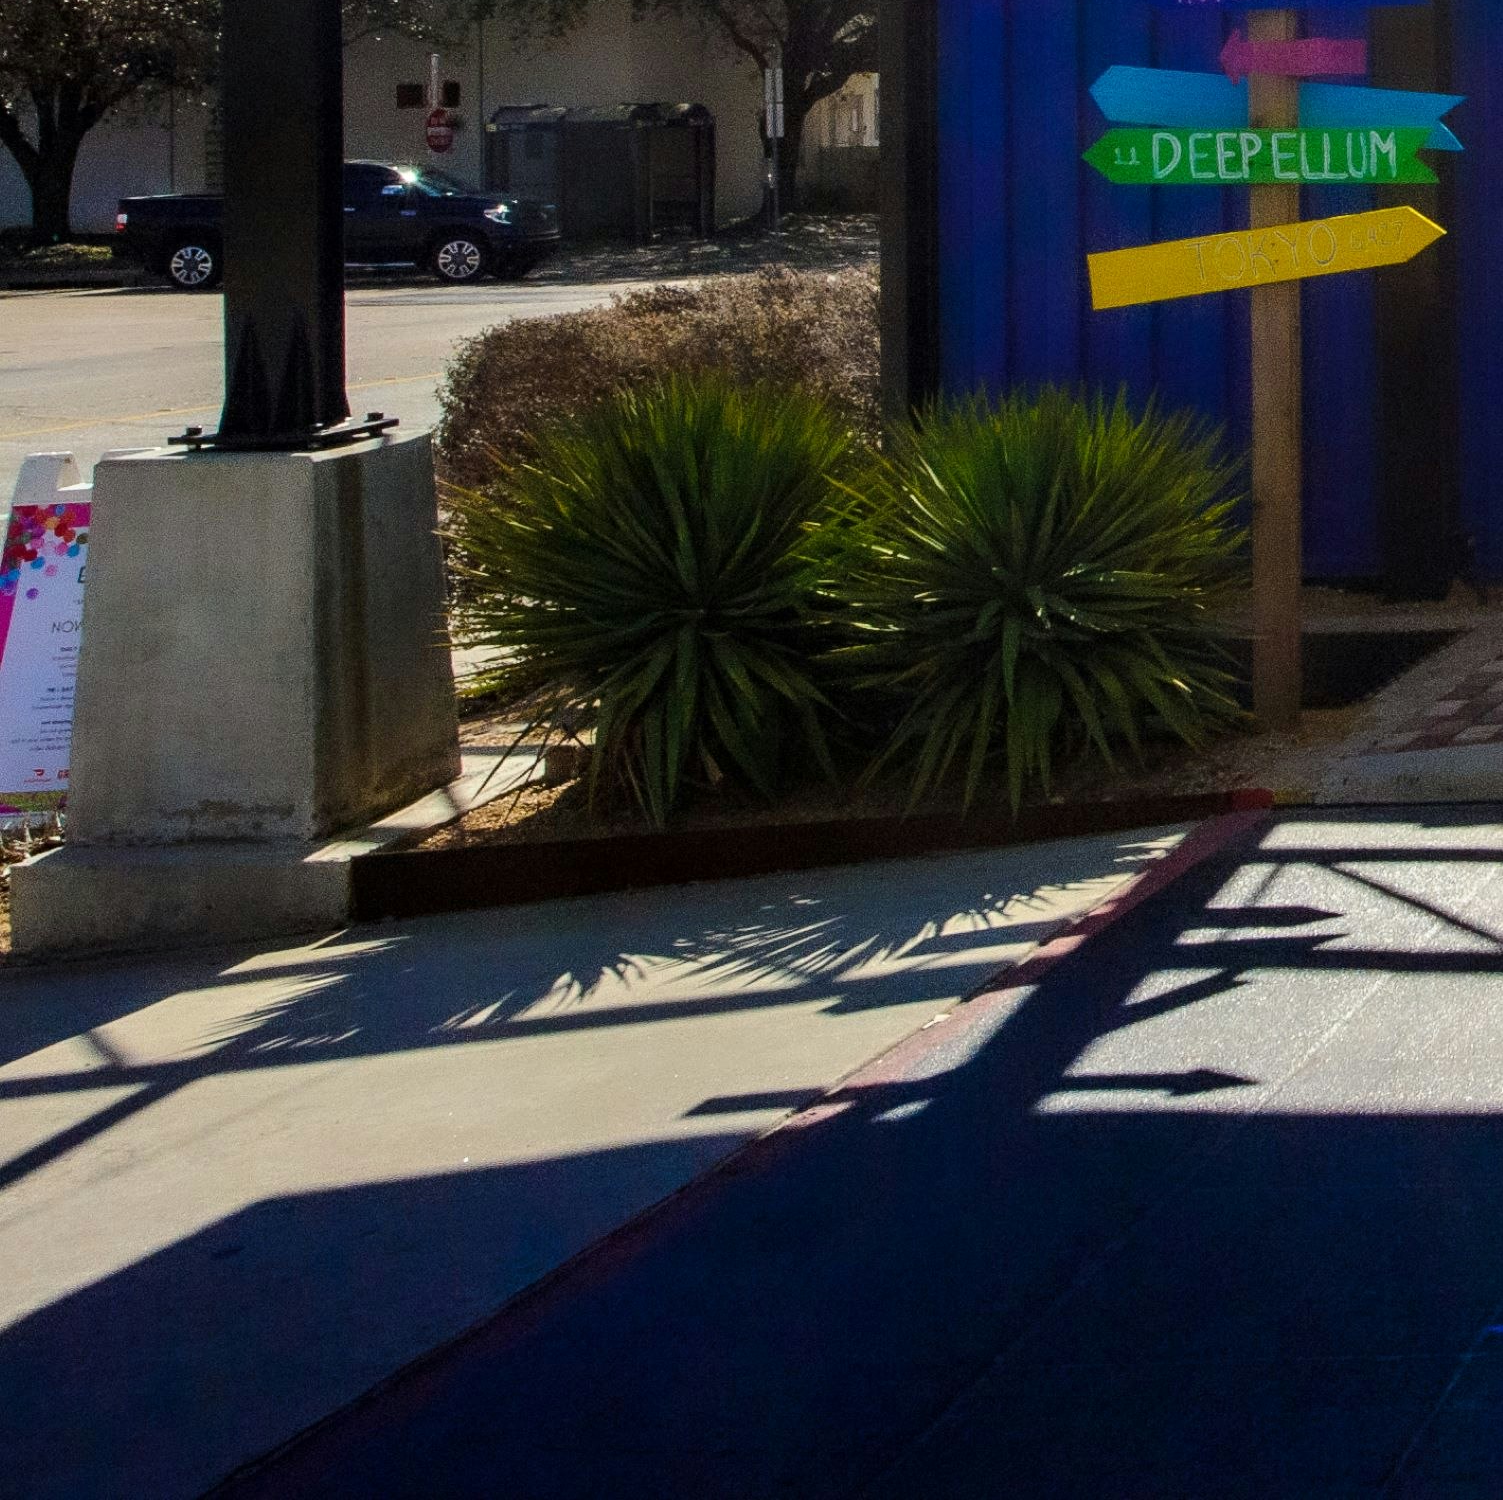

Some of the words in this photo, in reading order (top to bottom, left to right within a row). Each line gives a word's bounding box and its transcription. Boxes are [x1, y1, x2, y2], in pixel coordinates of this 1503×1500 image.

[1151, 132, 1263, 179] DEEP
[1271, 131, 1398, 179] ELLUM
[1185, 222, 1338, 285] TOKYO
